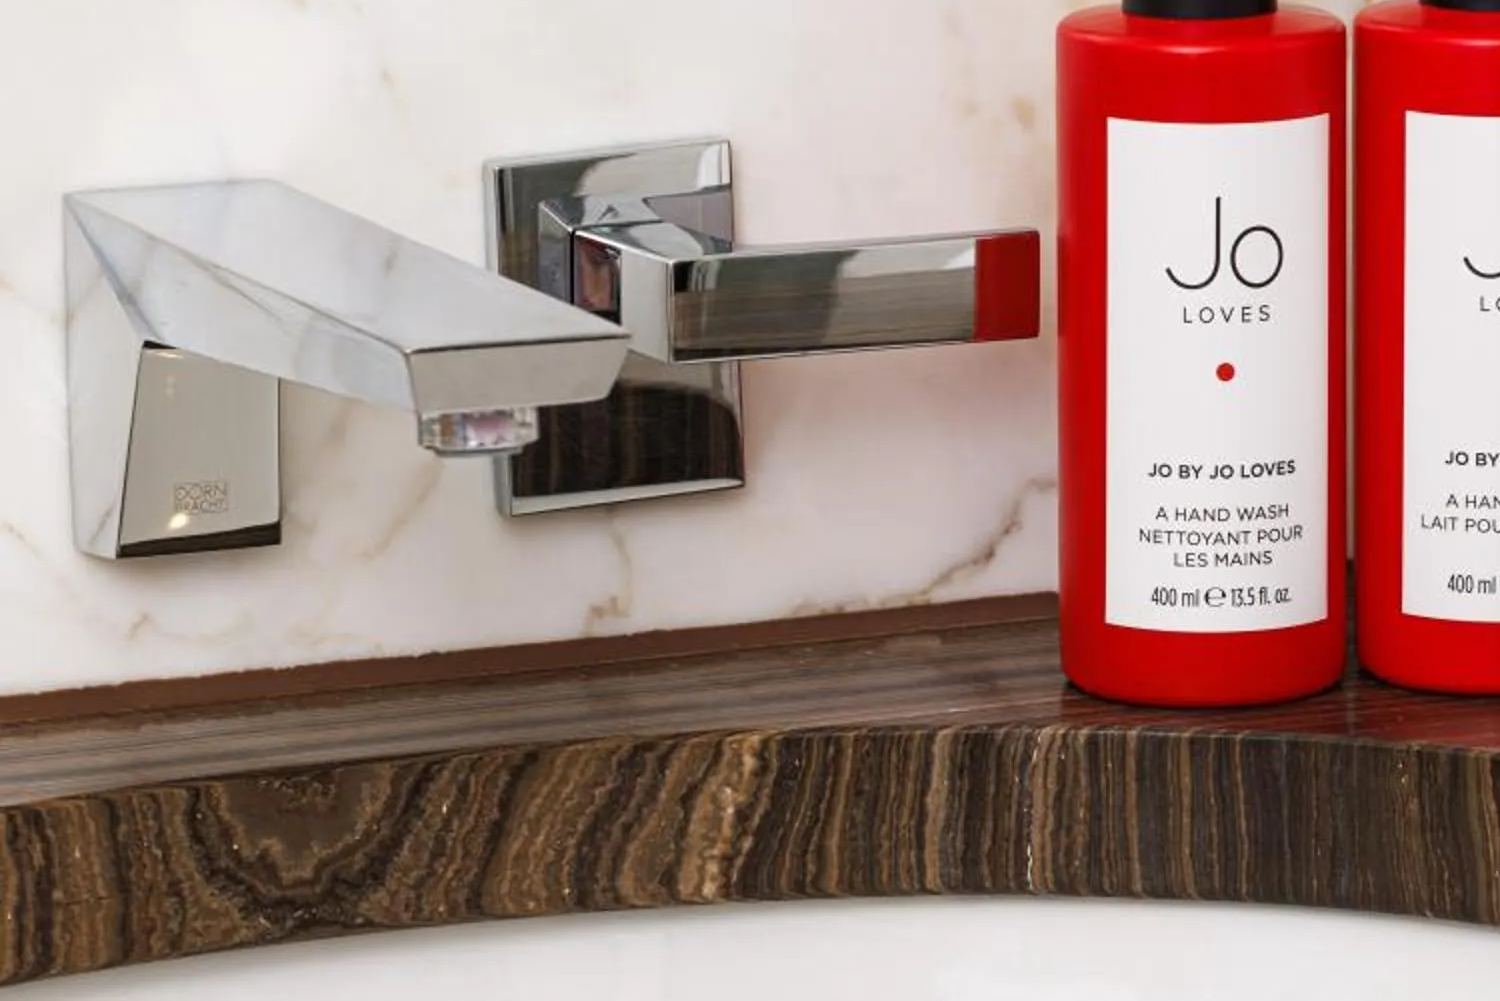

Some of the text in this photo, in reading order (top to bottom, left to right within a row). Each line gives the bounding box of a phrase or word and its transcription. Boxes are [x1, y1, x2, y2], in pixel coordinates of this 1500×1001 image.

[1164, 195, 1285, 291] Jo
[1183, 304, 1271, 324] LOVES
[1445, 450, 1470, 467] JO
[1475, 452, 1500, 468] BY
[1147, 459, 1297, 481] JO BY JO LOVES
[1445, 493, 1460, 509] A
[1155, 502, 1289, 523] A HAND WASH
[1420, 514, 1459, 532] LAIT
[1139, 524, 1303, 546] NETTOYANT POUR
[1173, 550, 1273, 568] LES MAINS
[1447, 573, 1475, 594] 400
[1477, 573, 1497, 594] ml
[1150, 586, 1178, 608] 400
[1181, 586, 1200, 608] ml
[1230, 586, 1256, 608] 13.5
